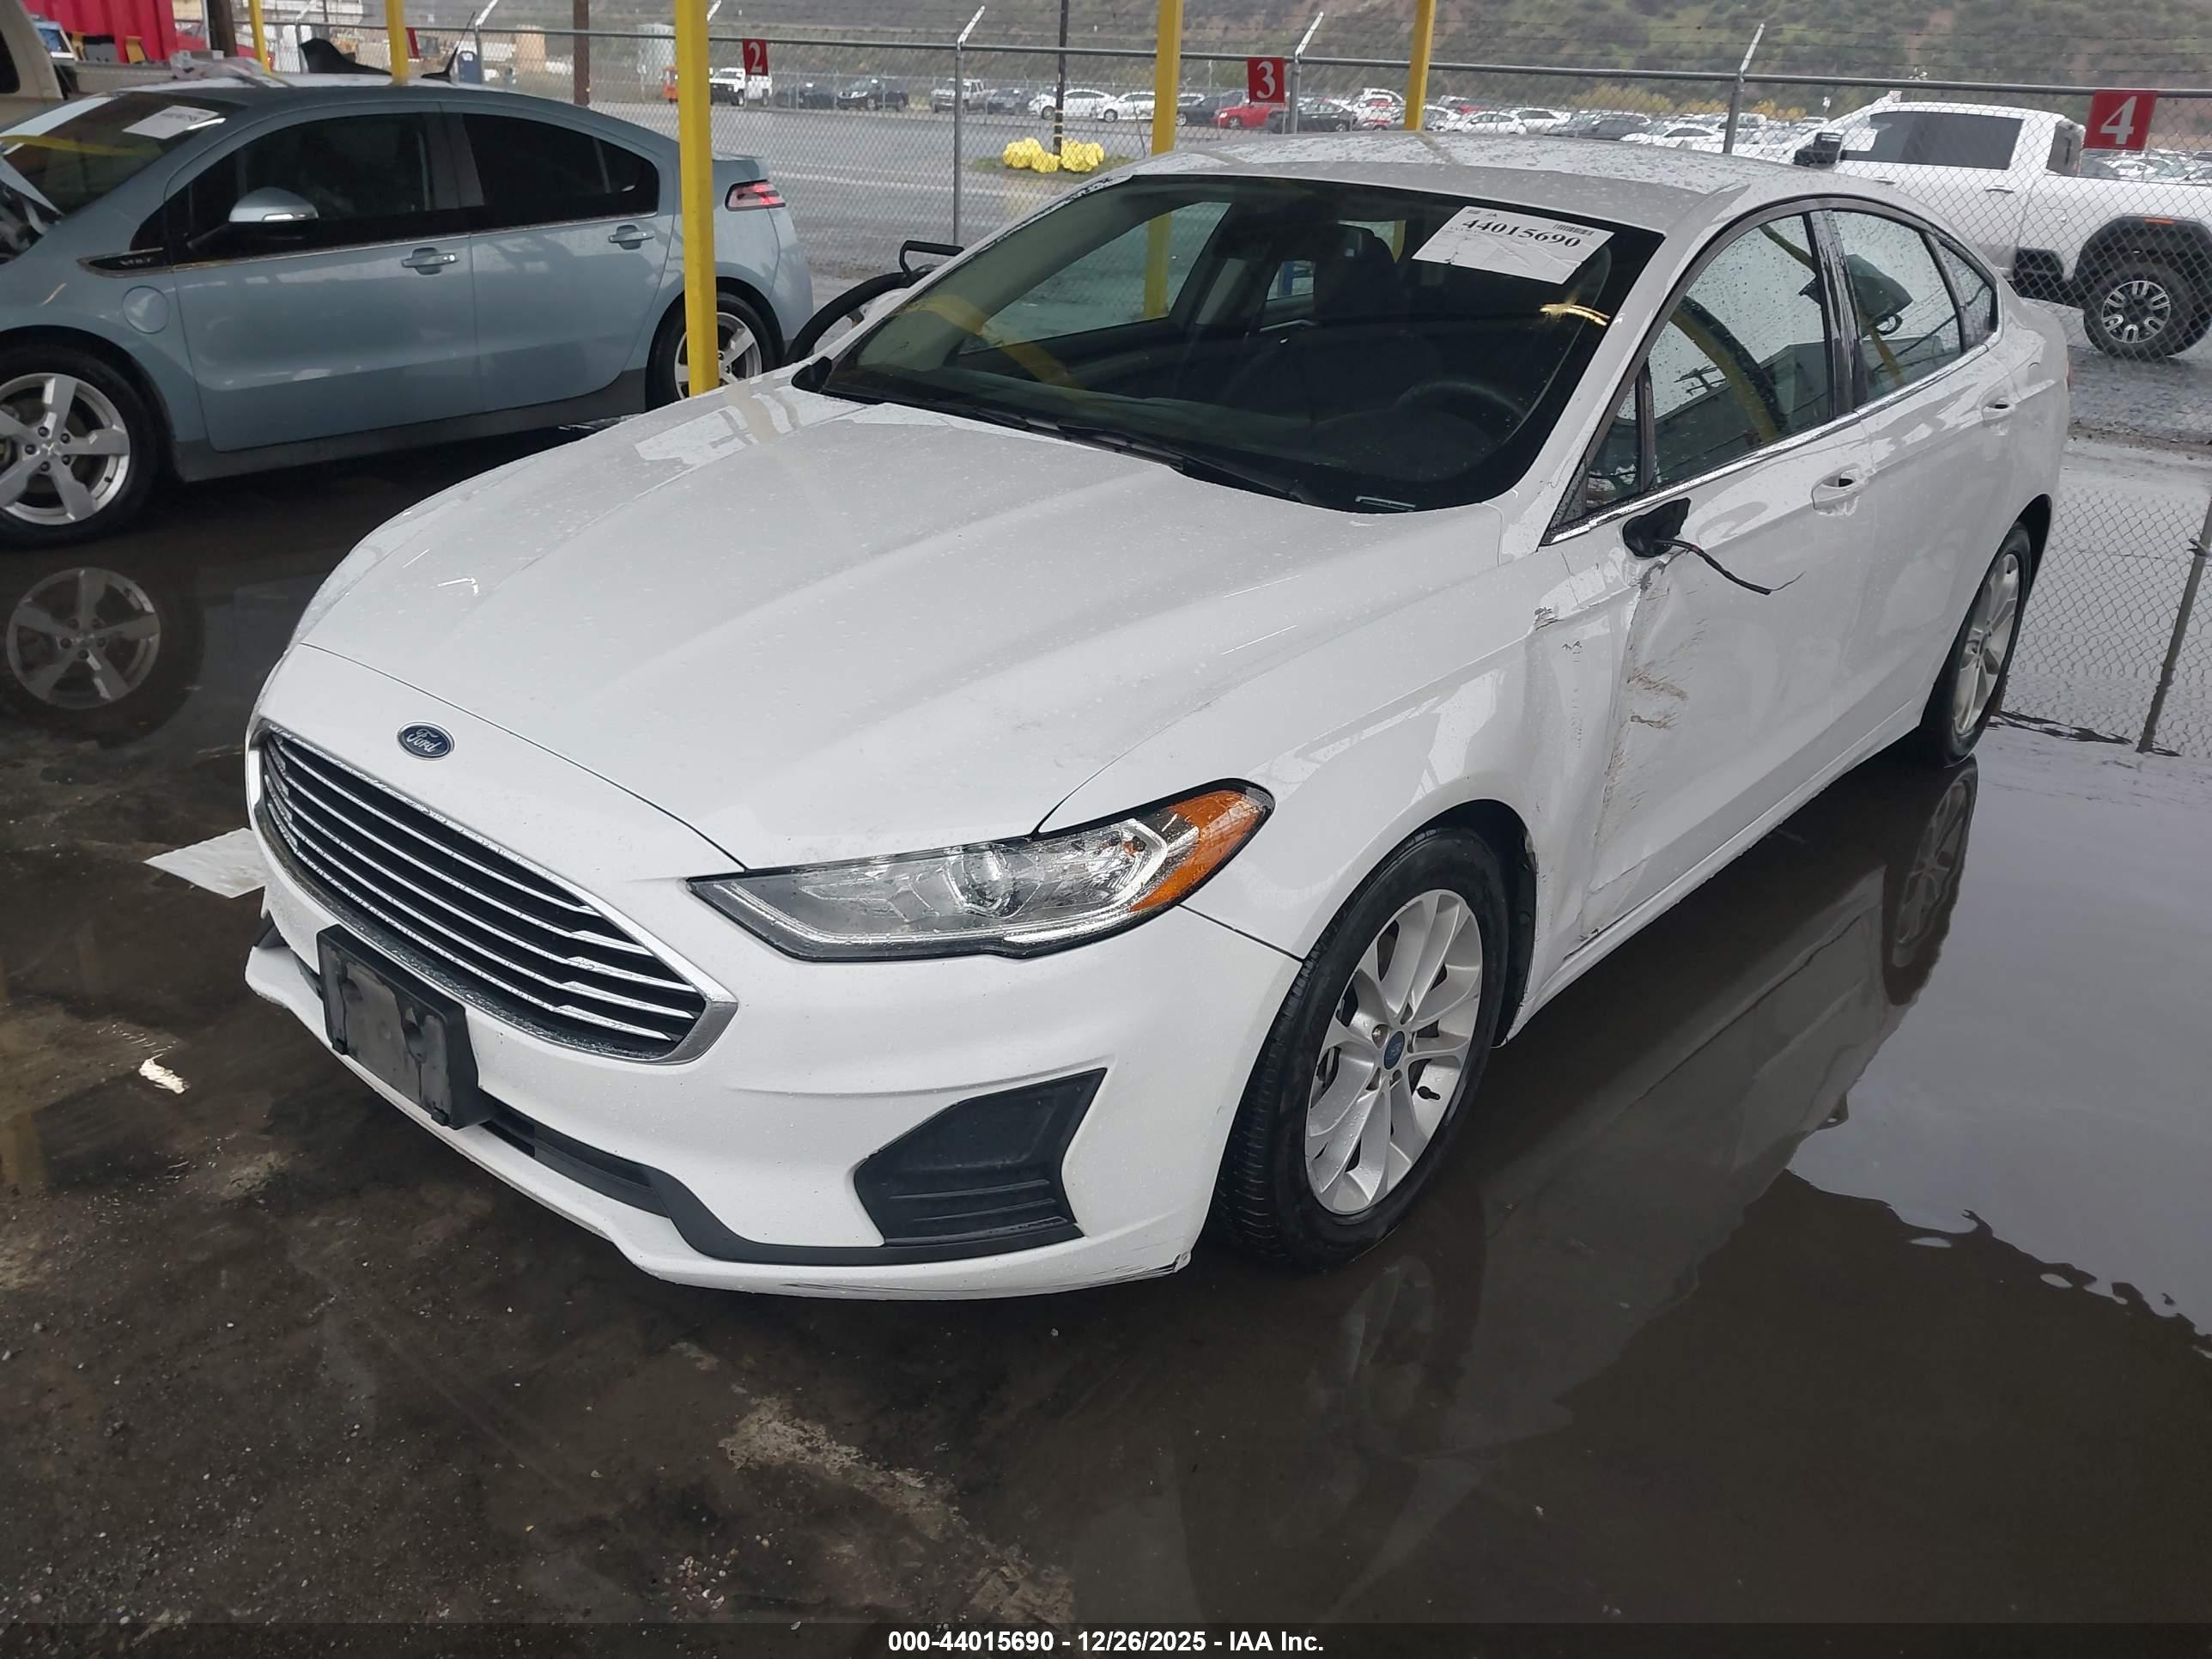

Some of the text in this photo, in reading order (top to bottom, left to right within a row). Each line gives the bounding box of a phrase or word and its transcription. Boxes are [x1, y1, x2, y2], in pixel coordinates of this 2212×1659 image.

[749, 41, 763, 73] 2
[1256, 61, 1276, 99] 3
[2100, 95, 2137, 144] 4
[1462, 219, 1582, 248] 44015690
[406, 728, 441, 753] Ford
